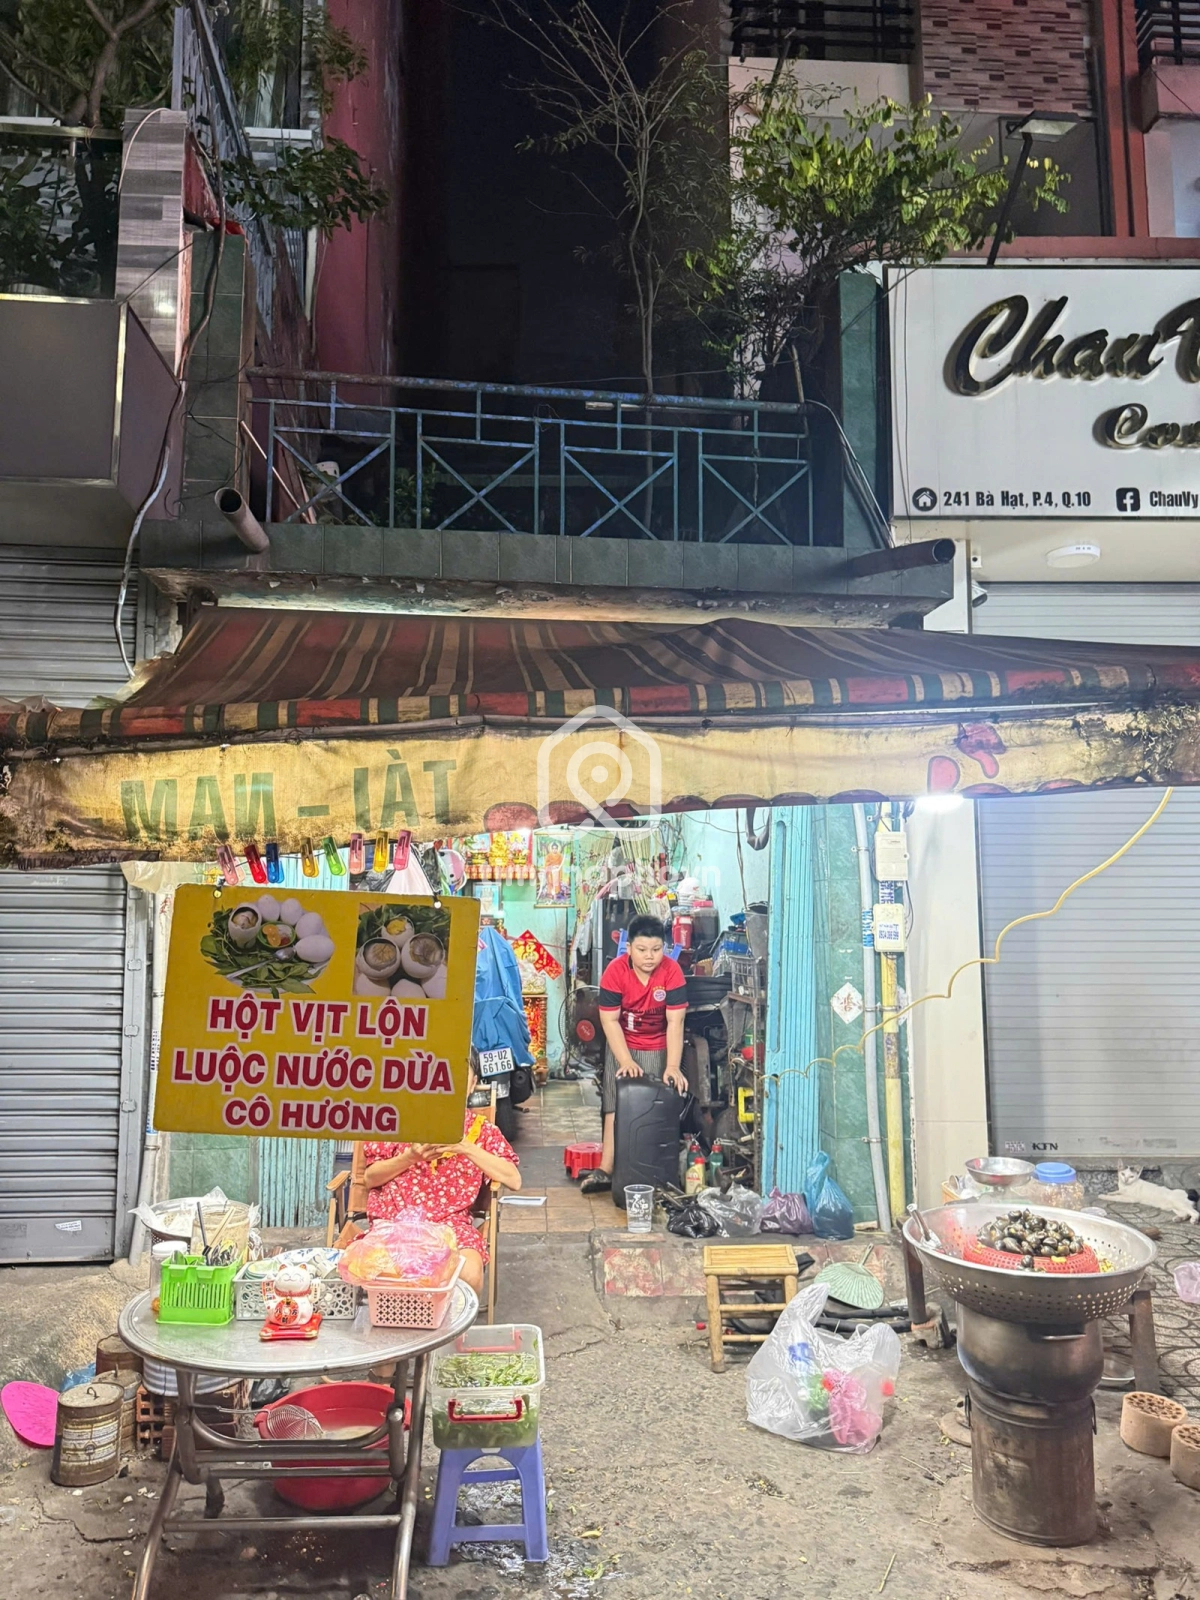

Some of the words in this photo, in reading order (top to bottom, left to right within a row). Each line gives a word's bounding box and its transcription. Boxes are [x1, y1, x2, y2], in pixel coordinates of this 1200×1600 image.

[943, 491, 970, 507] 241
[975, 490, 995, 507] Bà
[1000, 490, 1029, 510] Hạt,
[1061, 491, 1092, 509] Q.10
[1149, 490, 1199, 509] ChauVy
[208, 991, 283, 1041] HỘT
[291, 1000, 350, 1044] VỊT
[357, 997, 428, 1046] LỘN
[483, 1049, 508, 1064] 59-U2
[173, 1044, 268, 1094] LUỘC
[274, 1046, 375, 1090] NƯỚC
[382, 1050, 453, 1093] DỪA
[482, 1059, 512, 1075] 661.66
[224, 1094, 272, 1128] CÔ
[280, 1098, 398, 1133] HƯƠNG
